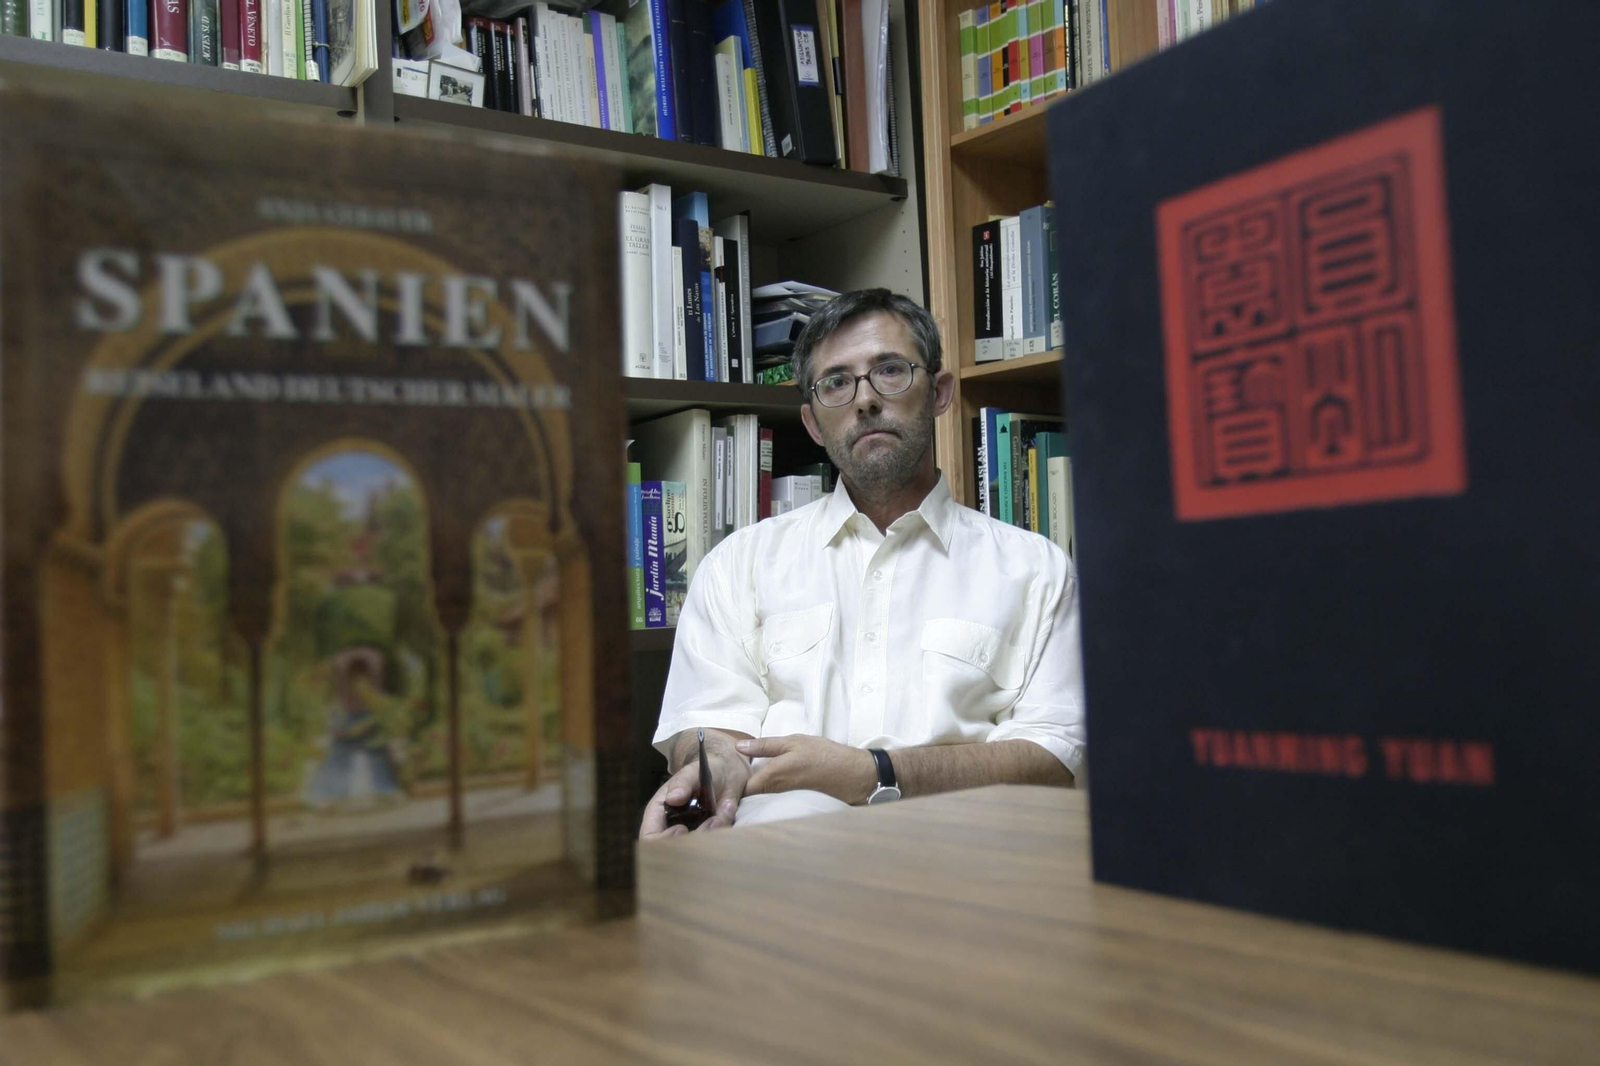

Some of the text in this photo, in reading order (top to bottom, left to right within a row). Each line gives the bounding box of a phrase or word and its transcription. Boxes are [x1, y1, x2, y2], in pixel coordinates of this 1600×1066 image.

[201, 16, 211, 61] ACTES SUD
[247, 12, 257, 46] VENETO
[75, 246, 573, 354] SPANIEN
[1051, 272, 1060, 309] CORÁN
[977, 447, 985, 478] ISLAM
[1012, 435, 1021, 503] Gardens of Persia
[633, 537, 641, 561] paisaje
[647, 516, 659, 558] Manía
[634, 568, 642, 609] arquitectura
[645, 560, 664, 601] jardín
